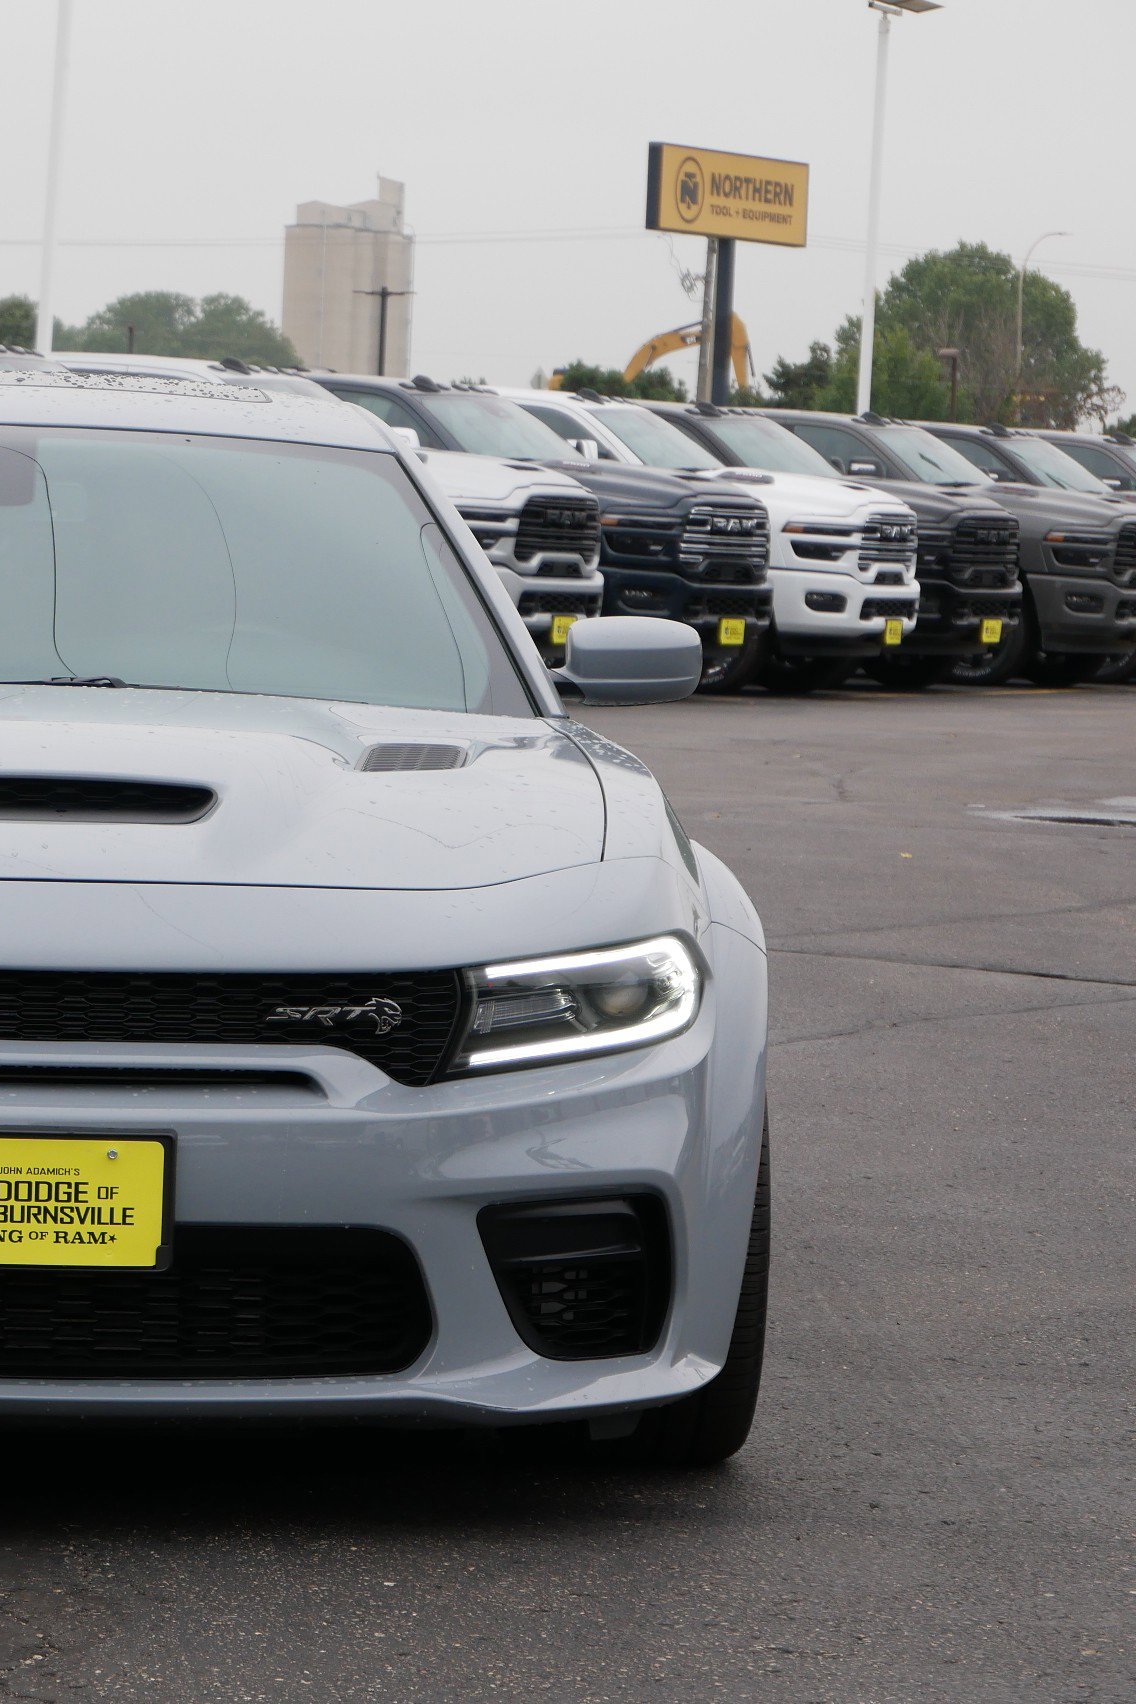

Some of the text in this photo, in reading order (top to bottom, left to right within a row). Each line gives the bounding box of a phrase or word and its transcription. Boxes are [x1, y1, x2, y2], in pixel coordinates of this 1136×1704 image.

[711, 173, 794, 206] NORTHERN
[710, 205, 732, 216] TOOL
[743, 210, 792, 224] EQUIPMENT
[545, 509, 587, 526] RAM
[712, 517, 757, 533] RAM
[881, 524, 912, 540] RAM
[265, 1006, 377, 1026] SRT
[26, 1167, 80, 1176] ADAMICH'S
[97, 1186, 119, 1200] OF
[28, 1231, 49, 1241] OF
[53, 1230, 108, 1245] RAM
